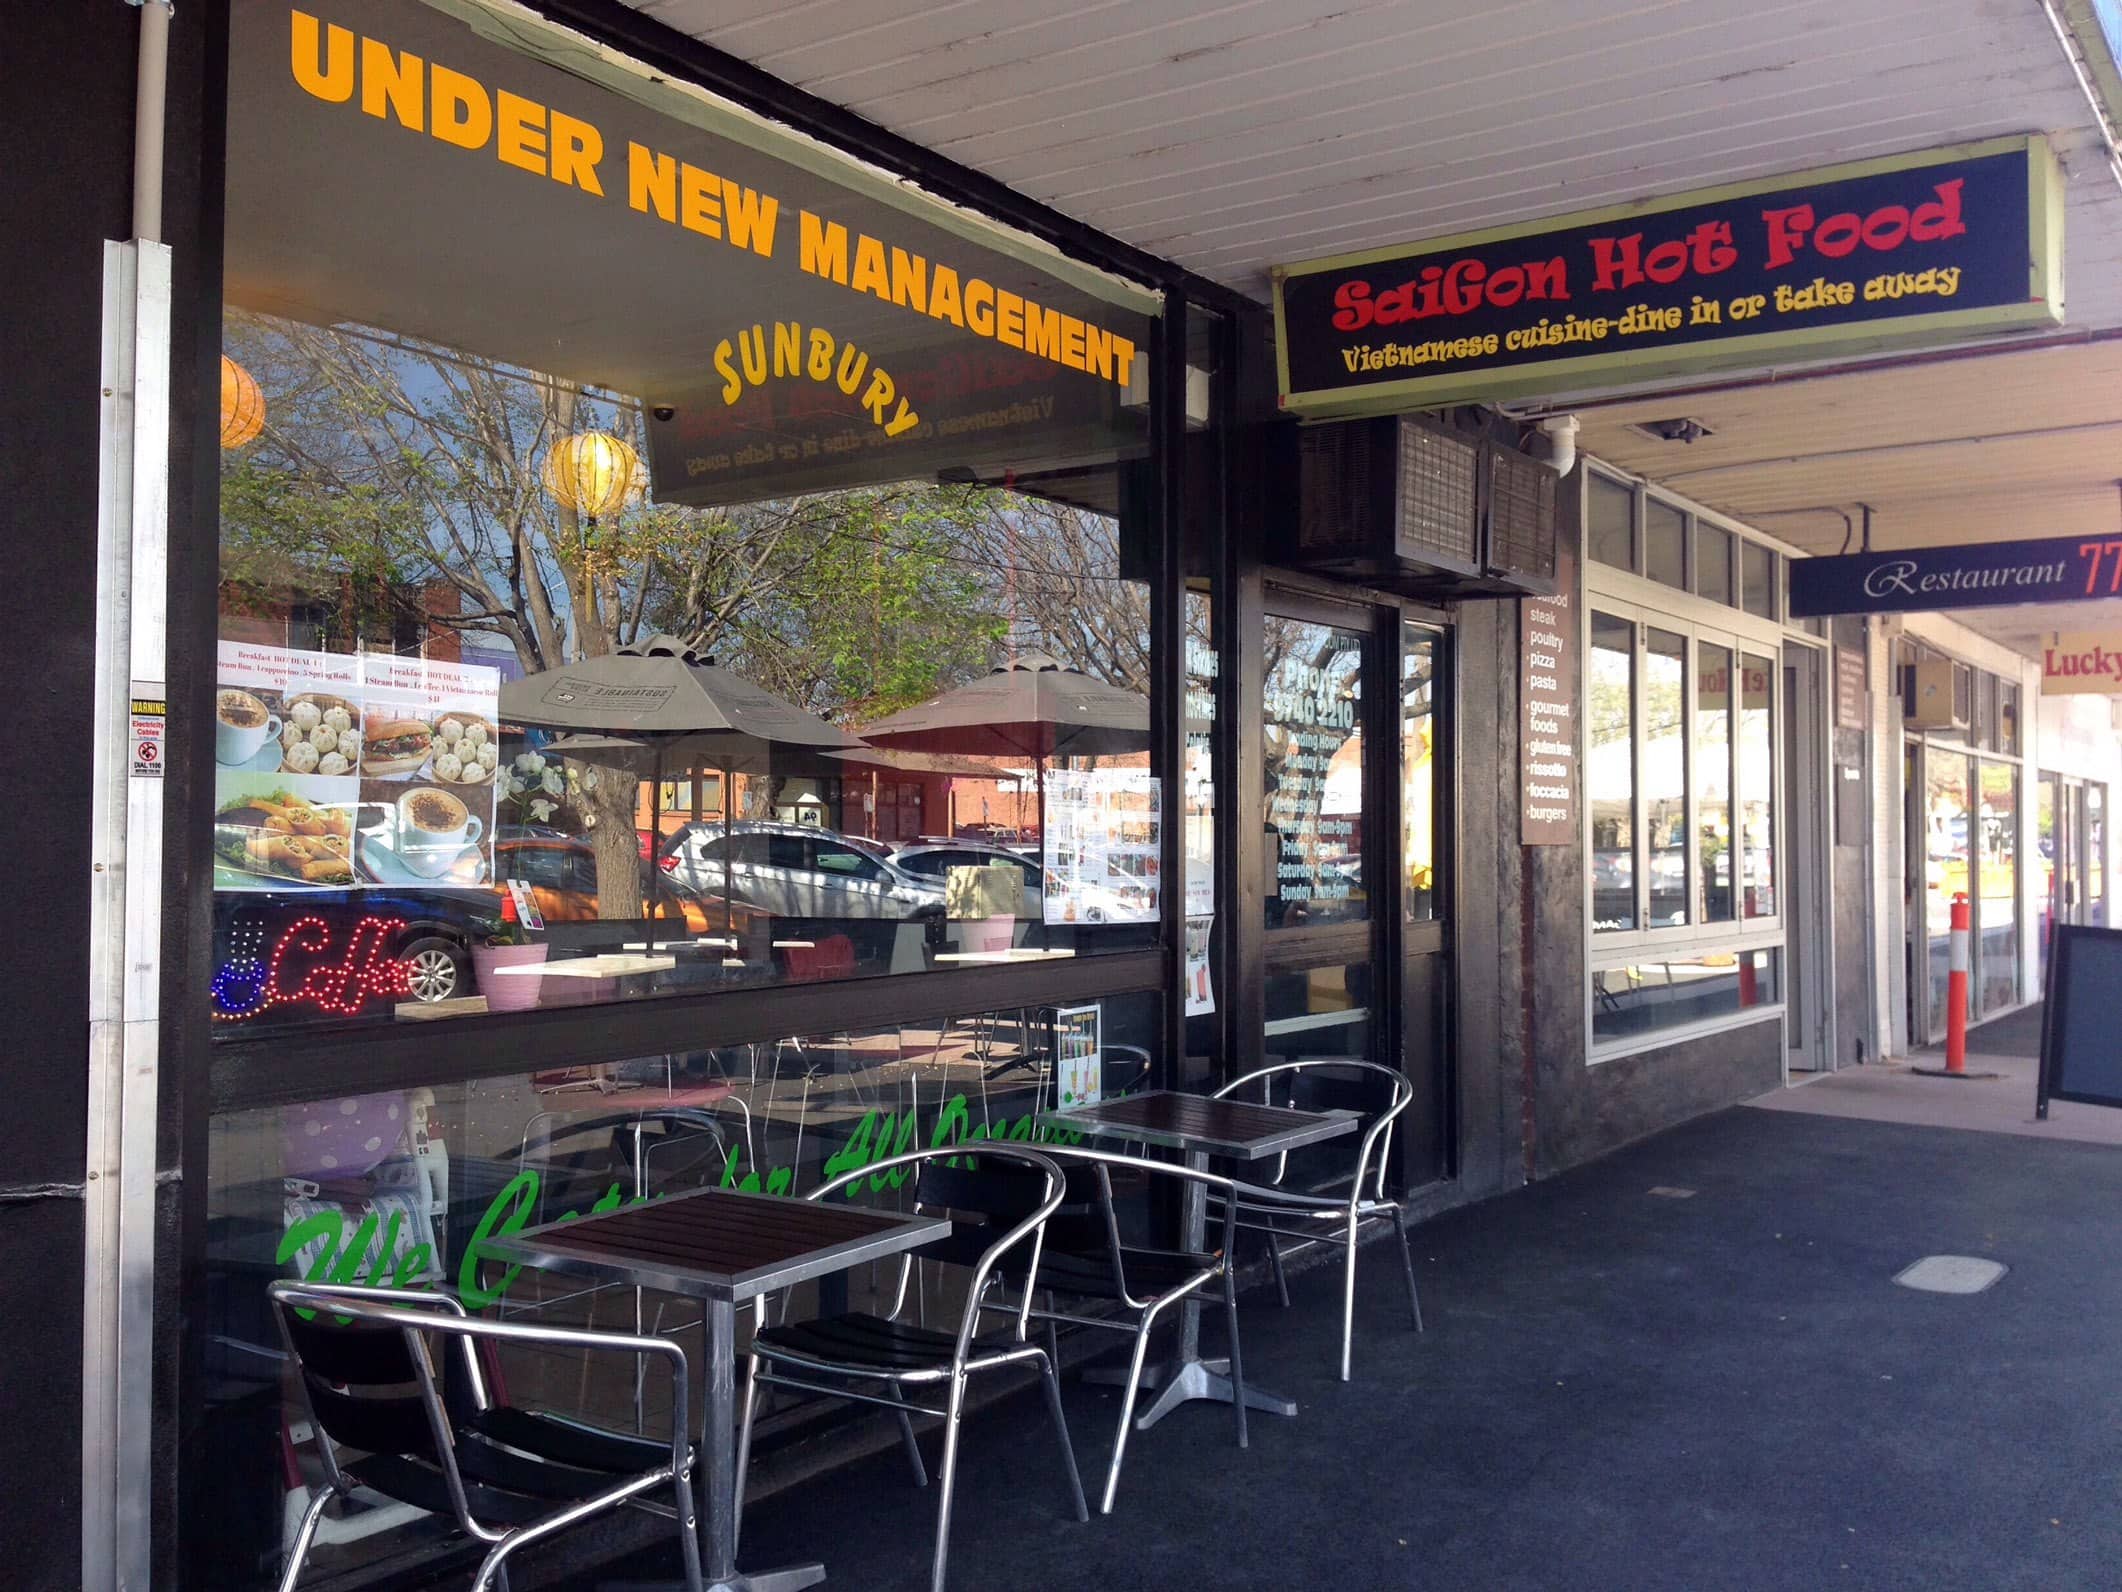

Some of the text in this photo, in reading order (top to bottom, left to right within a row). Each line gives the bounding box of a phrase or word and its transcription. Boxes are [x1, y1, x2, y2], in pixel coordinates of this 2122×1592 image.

[291, 9, 1134, 387] UNDER NEW MANAGEMENT
[1588, 221, 1738, 293] Hot
[1762, 178, 1966, 270] Food
[1341, 332, 1498, 373] Vietnamese
[1689, 296, 1721, 325] in
[1729, 294, 1766, 320] or
[1773, 277, 1855, 313] take
[1863, 267, 1961, 302] away
[713, 321, 920, 437] SUNBURY
[1864, 560, 2067, 598] Restaurant
[1530, 607, 1556, 627] steak
[1530, 631, 1564, 652] poultry
[1530, 650, 1556, 669] pizza
[2045, 646, 2122, 682] Lucky
[1530, 674, 1557, 691] pasta
[131, 701, 166, 714] WARNING
[1530, 698, 1569, 717] gourmet
[1530, 717, 1558, 735] foods
[1530, 804, 1567, 823] burgers
[1280, 883, 1312, 902] Sunday
[824, 1107, 915, 1198] All
